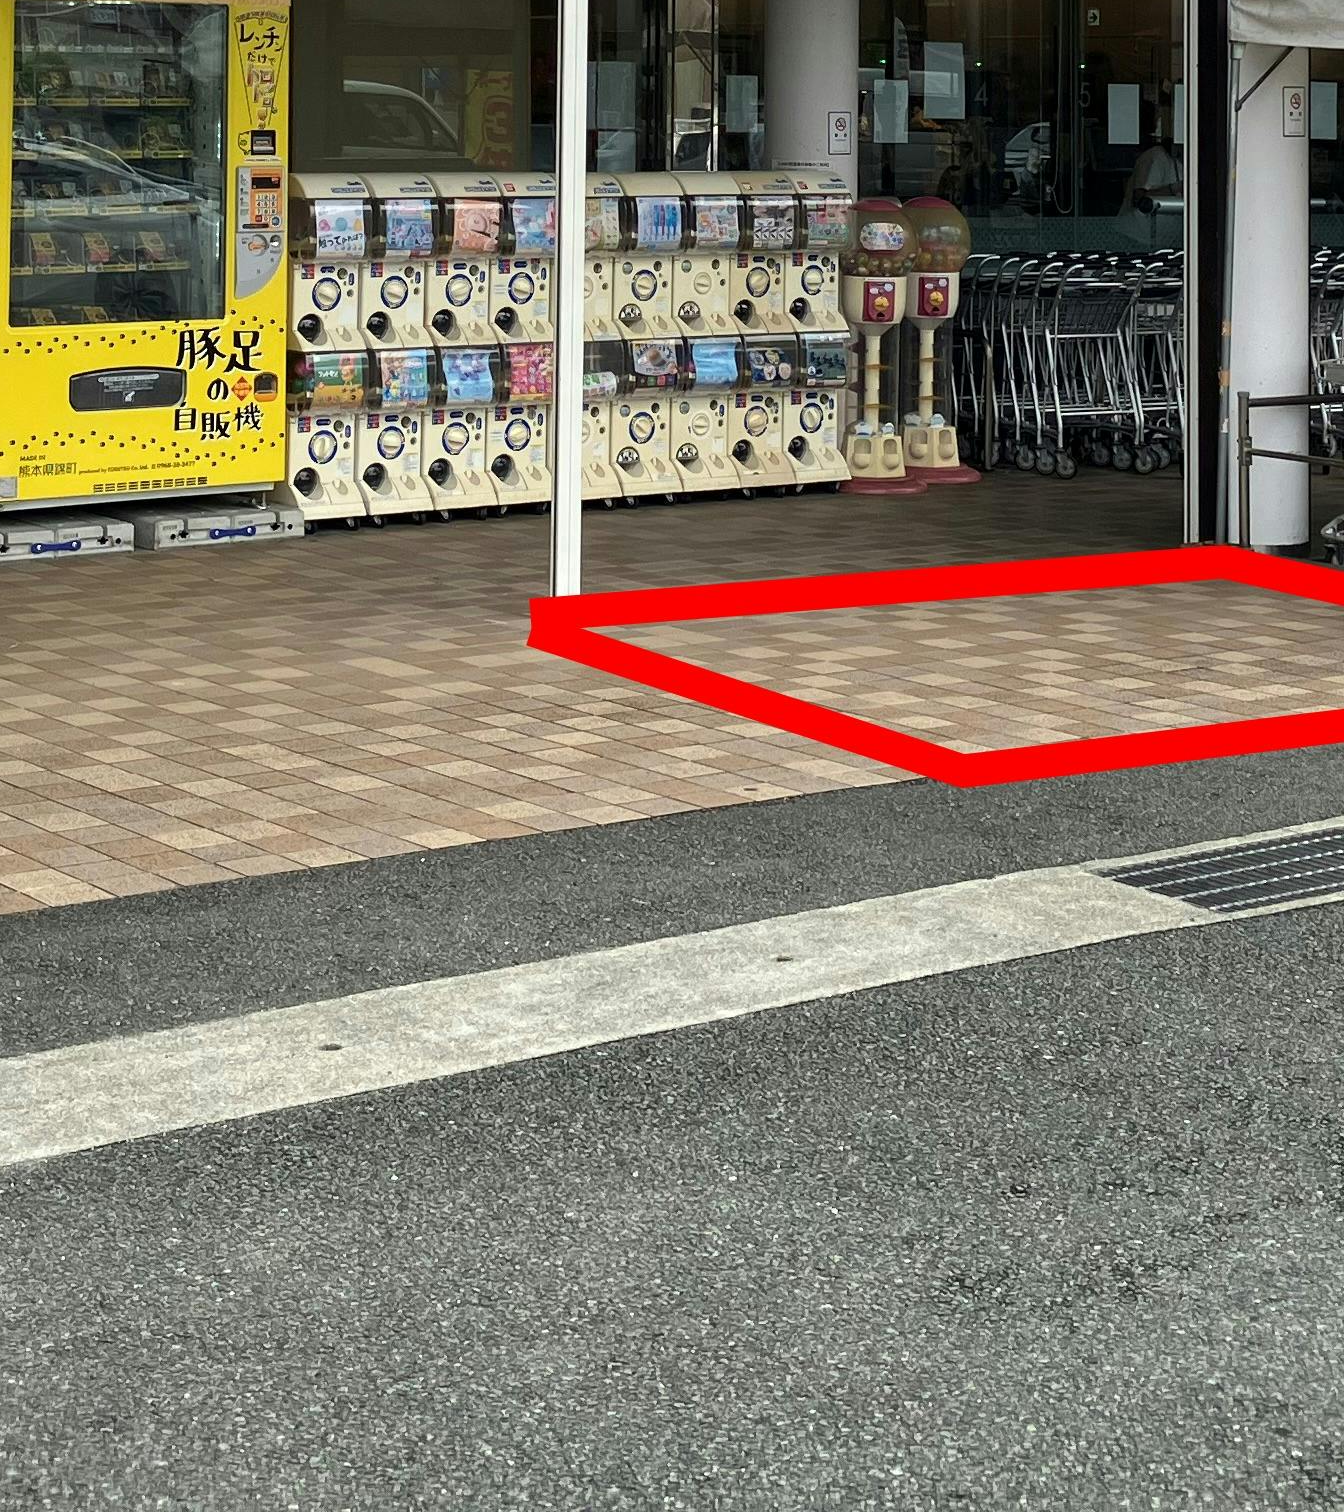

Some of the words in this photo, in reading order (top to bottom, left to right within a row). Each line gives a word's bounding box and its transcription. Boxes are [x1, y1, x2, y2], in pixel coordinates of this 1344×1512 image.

[176, 327, 264, 373] 豚足
[207, 378, 229, 400] の
[174, 402, 264, 441] 自販機
